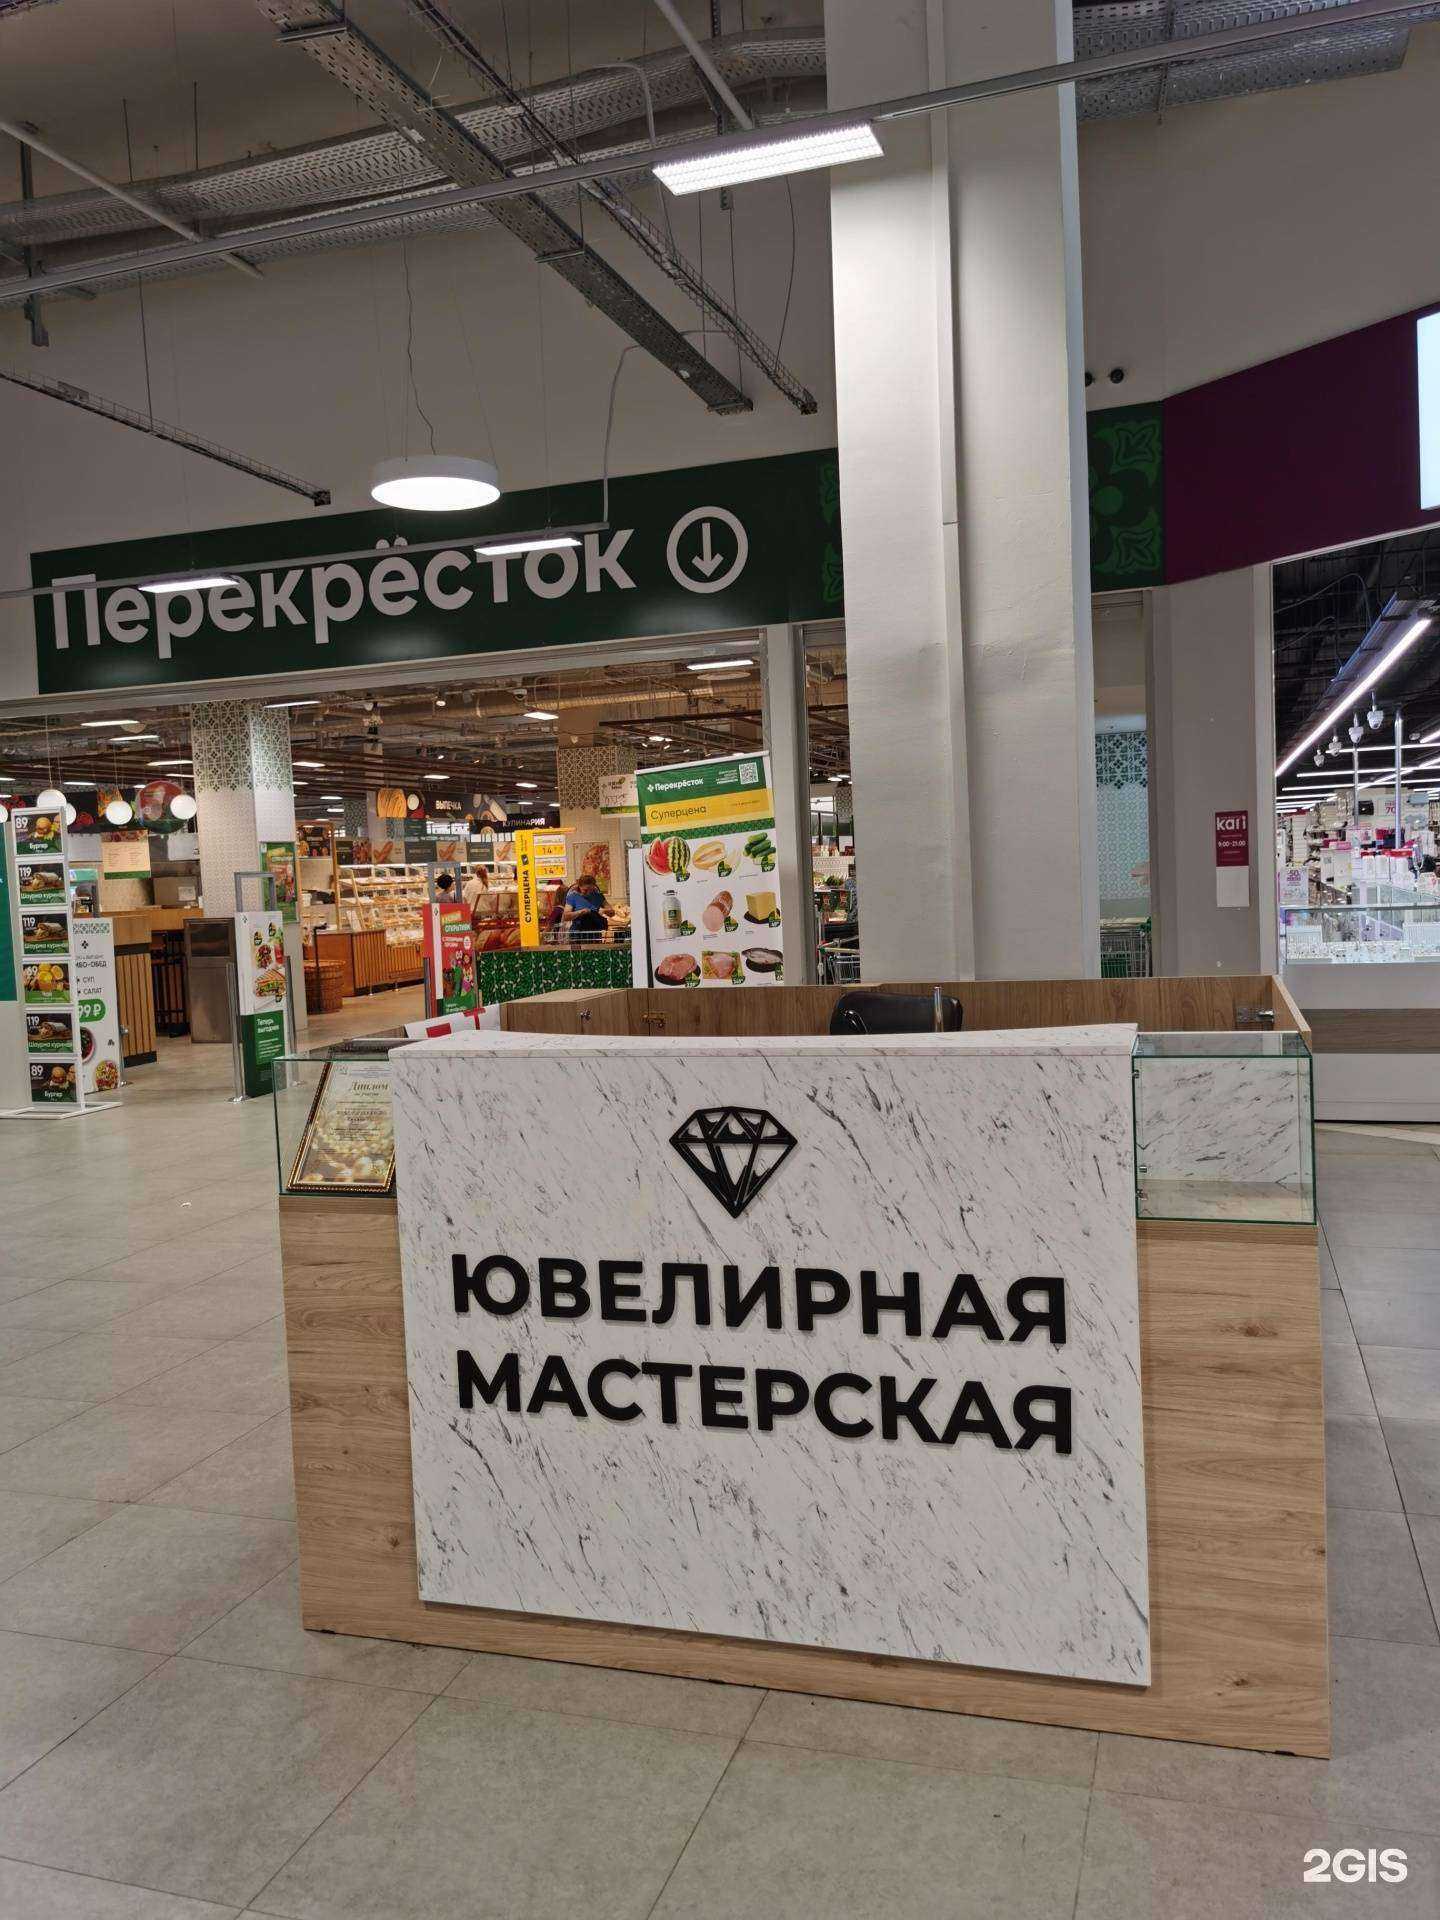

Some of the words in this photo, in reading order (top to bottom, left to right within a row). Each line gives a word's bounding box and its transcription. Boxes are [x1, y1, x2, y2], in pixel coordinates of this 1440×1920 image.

[52, 528, 637, 660] Перекрёсток
[654, 777, 704, 792] Перекрёсток
[436, 800, 462, 811] ВЫПЕЧКА
[650, 805, 707, 821] Суперцена
[15, 817, 29, 829] 89
[502, 817, 546, 828] КУЛИНАРИЯ
[1216, 815, 1247, 831] kari
[522, 870, 532, 923] СУПЕРЦЕНА
[22, 917, 36, 928] 119
[26, 1016, 40, 1027] 119
[30, 1065, 44, 1076] 89
[452, 1253, 1067, 1345] ЮВЕЛИРНАЯ
[456, 1349, 1072, 1455] МАСТЕРСКАЯ
